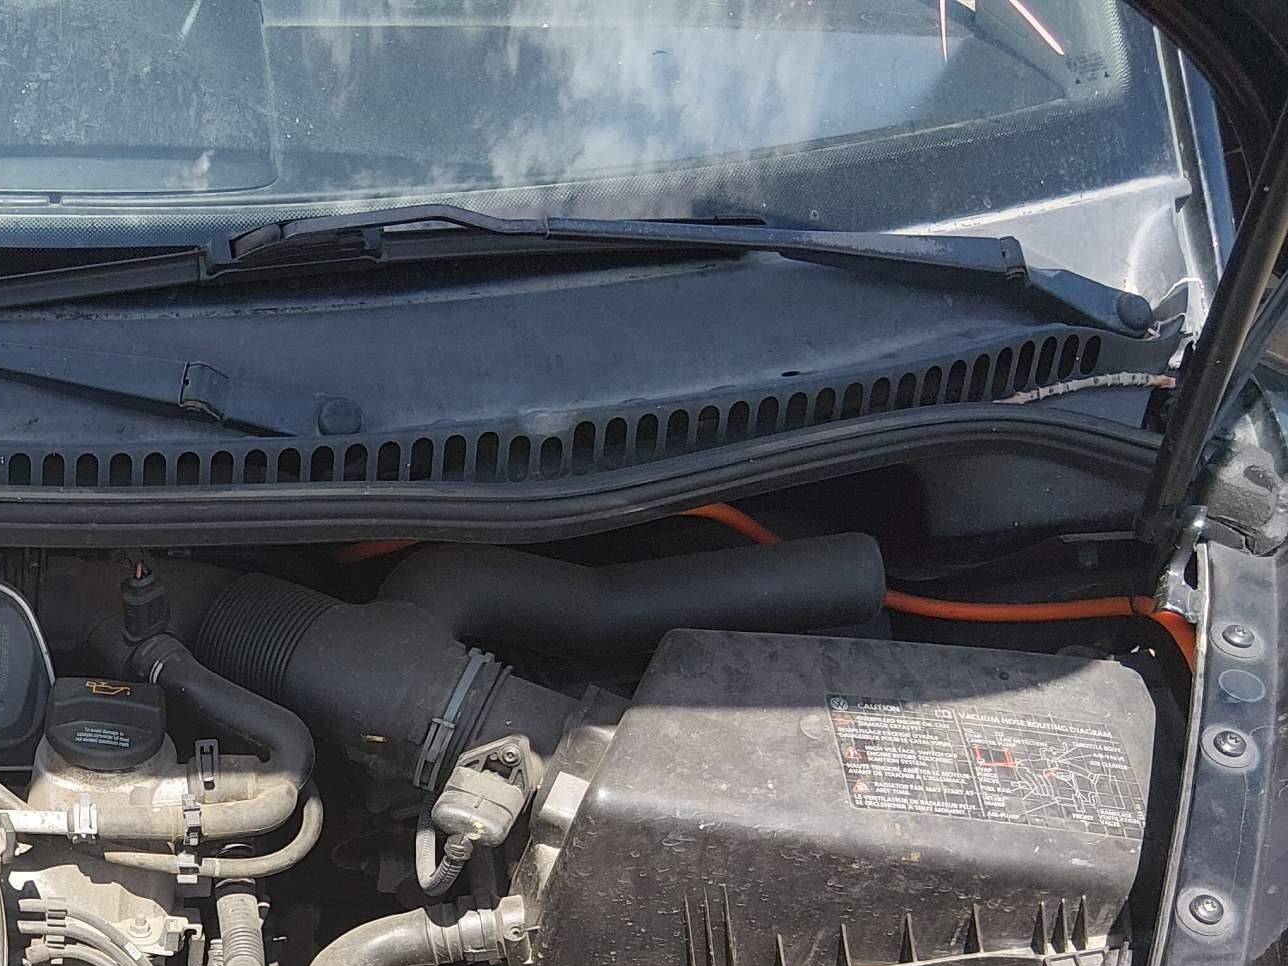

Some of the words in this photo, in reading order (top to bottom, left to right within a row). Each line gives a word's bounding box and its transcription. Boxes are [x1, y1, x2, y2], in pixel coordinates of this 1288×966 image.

[857, 702, 901, 712] CAUTION
[959, 712, 1000, 724] VACUUM
[1001, 717, 1023, 726] HOSE
[1024, 719, 1068, 732] ROUTING
[1069, 726, 1113, 738] DIAGRAM
